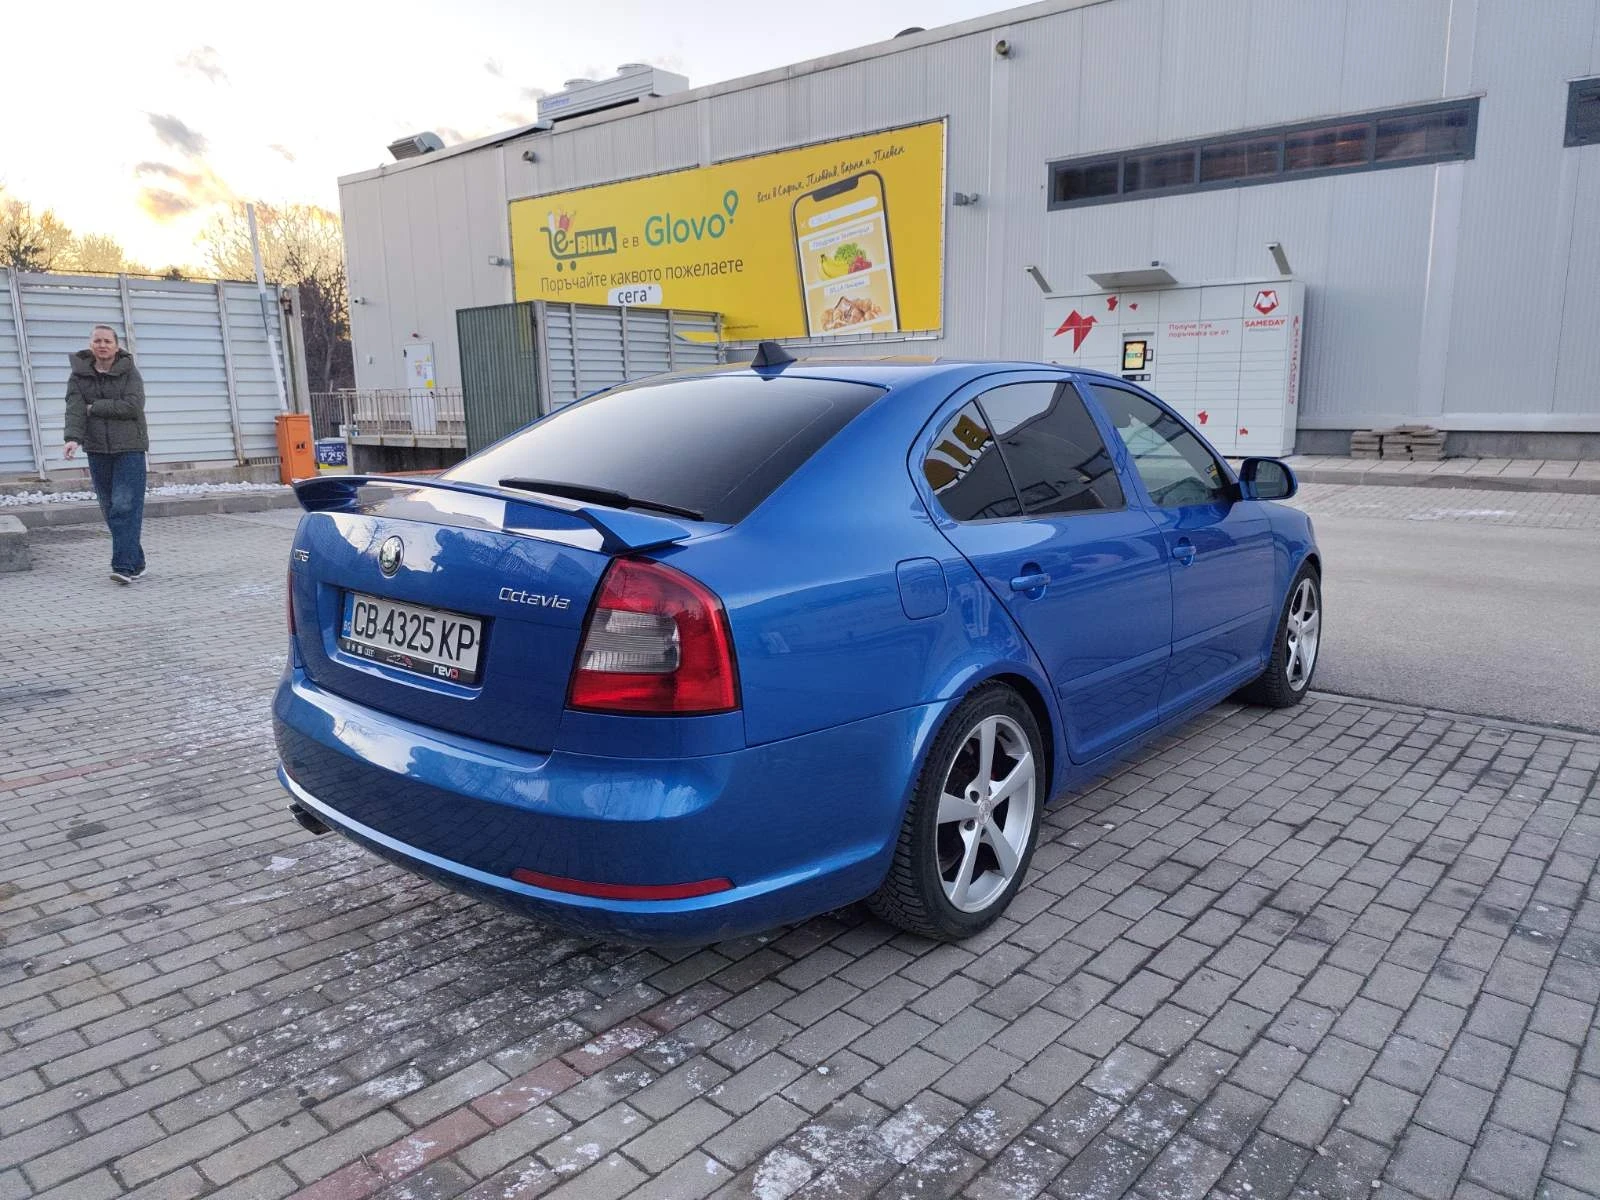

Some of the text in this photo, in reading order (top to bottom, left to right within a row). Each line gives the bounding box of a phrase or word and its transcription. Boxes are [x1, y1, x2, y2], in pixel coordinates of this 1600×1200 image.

[644, 211, 727, 247] Glovo
[540, 257, 744, 296] Поръчайте каквото пожелаете
[1244, 319, 1286, 328] SAMEDAY
[498, 586, 571, 610] Octavia
